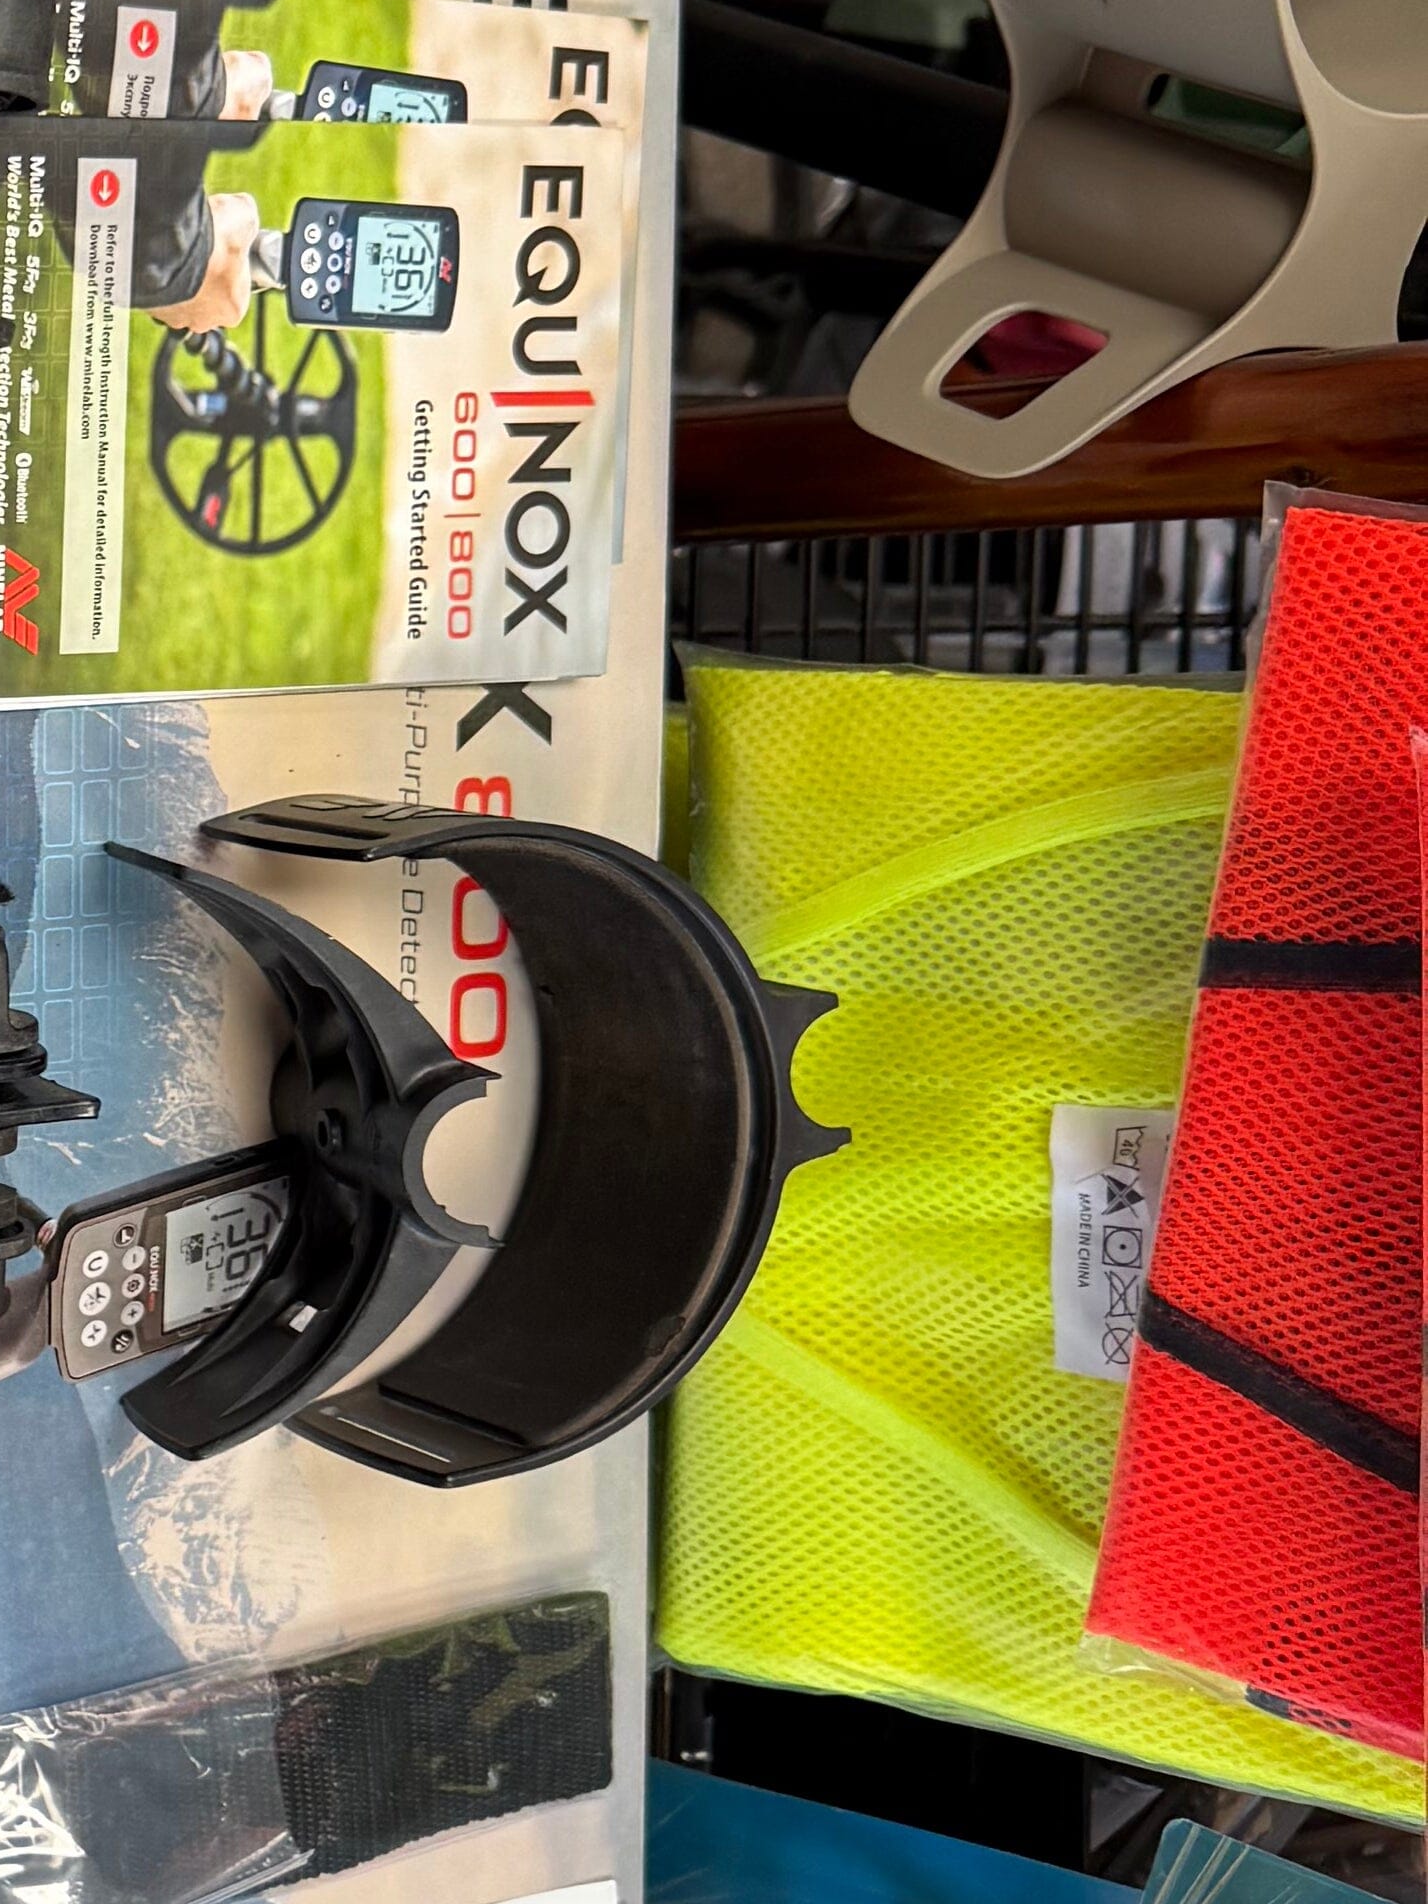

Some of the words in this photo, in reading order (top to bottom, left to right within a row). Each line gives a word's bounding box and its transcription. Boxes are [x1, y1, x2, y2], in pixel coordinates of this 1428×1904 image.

[5, 156, 22, 222] World's
[3, 224, 20, 265] Best
[86, 224, 102, 287] Download
[103, 224, 118, 257] Refer
[0, 267, 17, 320] Metal
[102, 277, 117, 297] the
[103, 261, 117, 274] to
[85, 290, 100, 320] from
[97, 300, 116, 368] full-length
[80, 323, 97, 440] www.minelab.com
[97, 371, 113, 438] Instruction
[96, 441, 110, 487] Manual
[406, 400, 434, 484] Getting
[15, 467, 30, 524] Bluetooth
[95, 490, 109, 507] for
[94, 510, 108, 561] detailed
[408, 488, 432, 571] Started
[91, 563, 106, 640] information.
[406, 577, 429, 640] Guide
[1078, 1193, 1093, 1229] MADE
[1078, 1232, 1092, 1245] IN
[1077, 1248, 1091, 1288] CHINA
